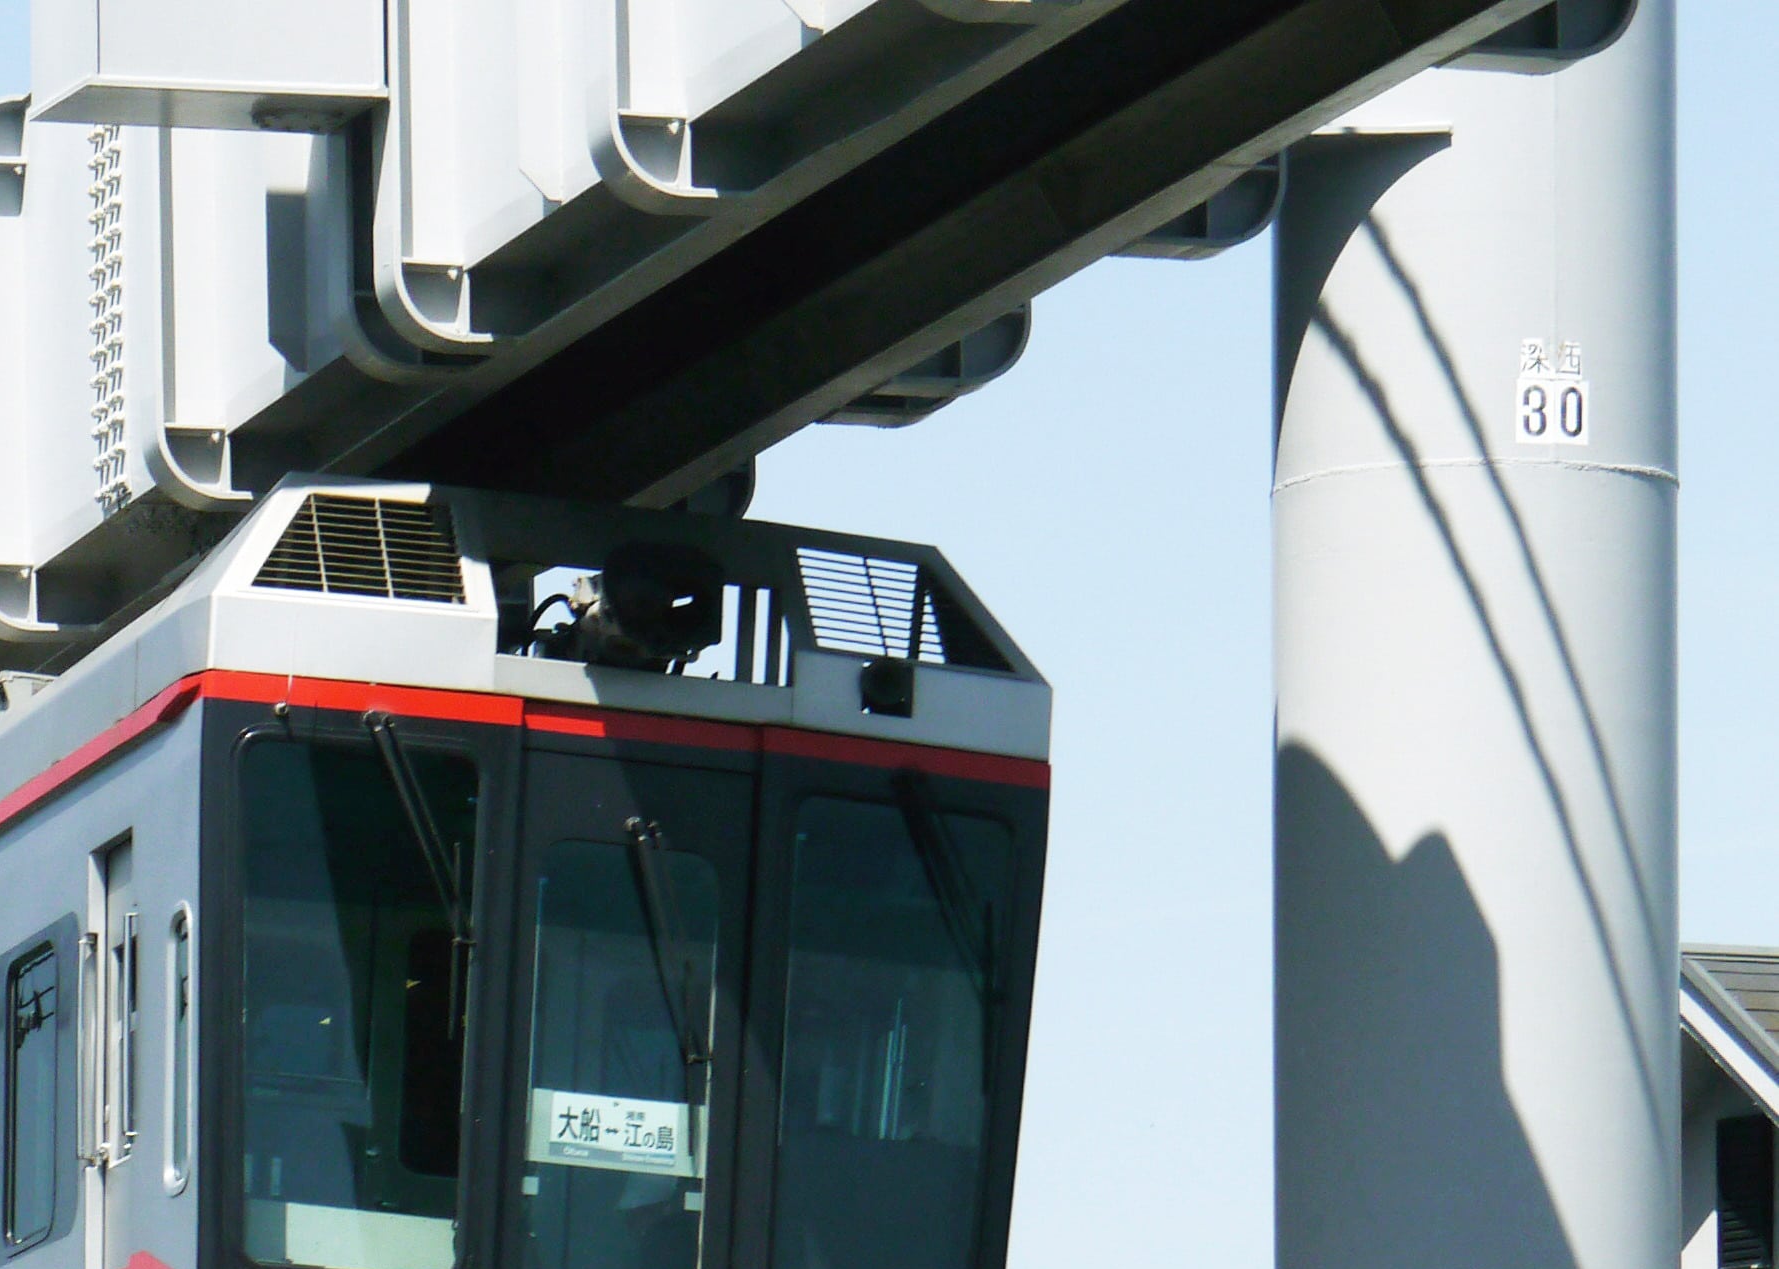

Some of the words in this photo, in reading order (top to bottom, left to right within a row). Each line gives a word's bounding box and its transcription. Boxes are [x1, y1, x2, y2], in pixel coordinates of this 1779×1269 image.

[1522, 384, 1584, 438] 30
[557, 1105, 601, 1144] 大船
[623, 1121, 675, 1152] 江の島
